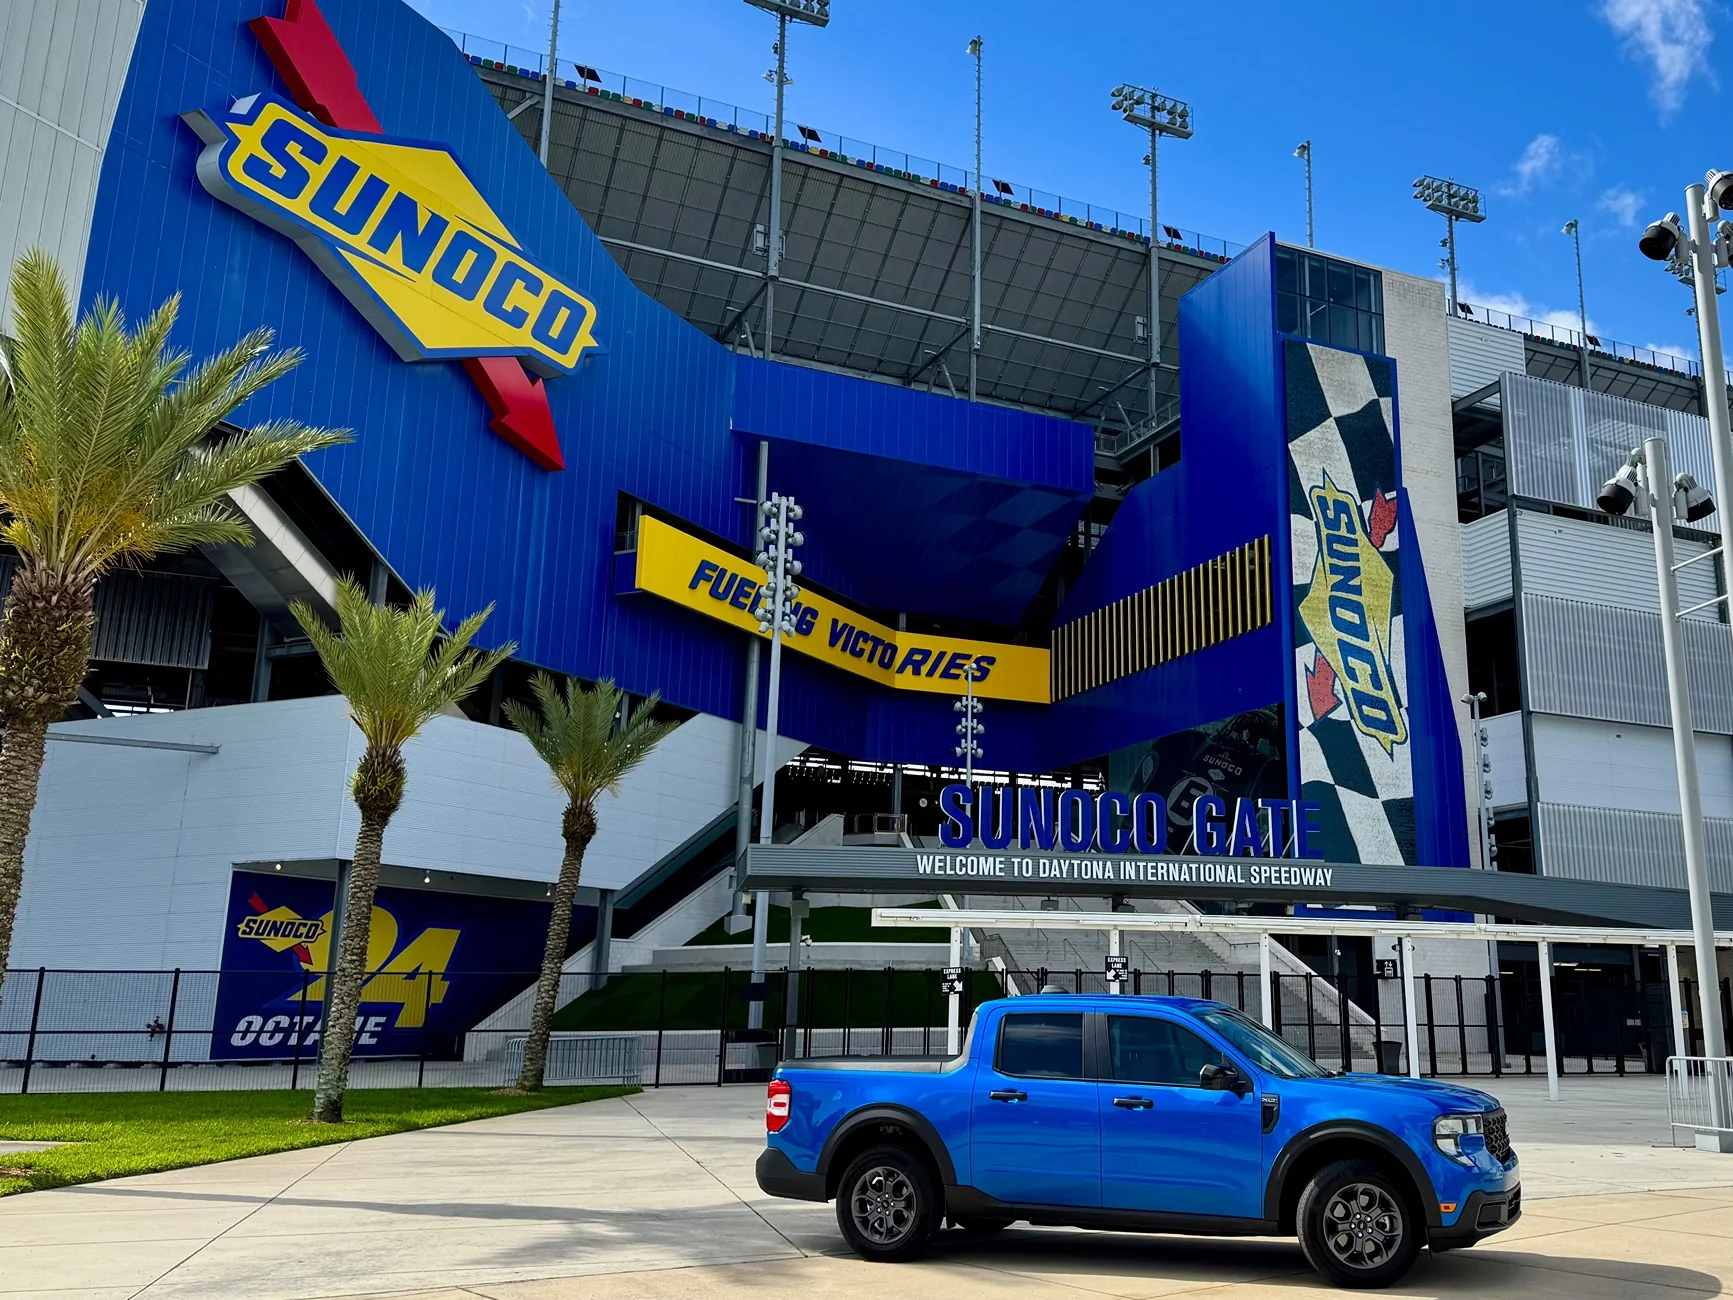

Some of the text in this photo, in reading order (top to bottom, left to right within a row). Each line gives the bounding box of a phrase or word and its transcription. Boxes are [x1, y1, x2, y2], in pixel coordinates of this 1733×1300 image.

[241, 117, 589, 357] SUNOCO
[688, 559, 997, 683] FUELG VICTORIES
[1317, 495, 1397, 735] SUNOCO
[1203, 753, 1243, 776] SUNOCO
[938, 783, 1325, 862] SUNOCO GATE
[916, 854, 1333, 887] WELCOME TO DAYTONA INTERNATIONAL SPEEDWAY
[241, 917, 320, 941] SUNOCO
[230, 1014, 387, 1047] OCTE
